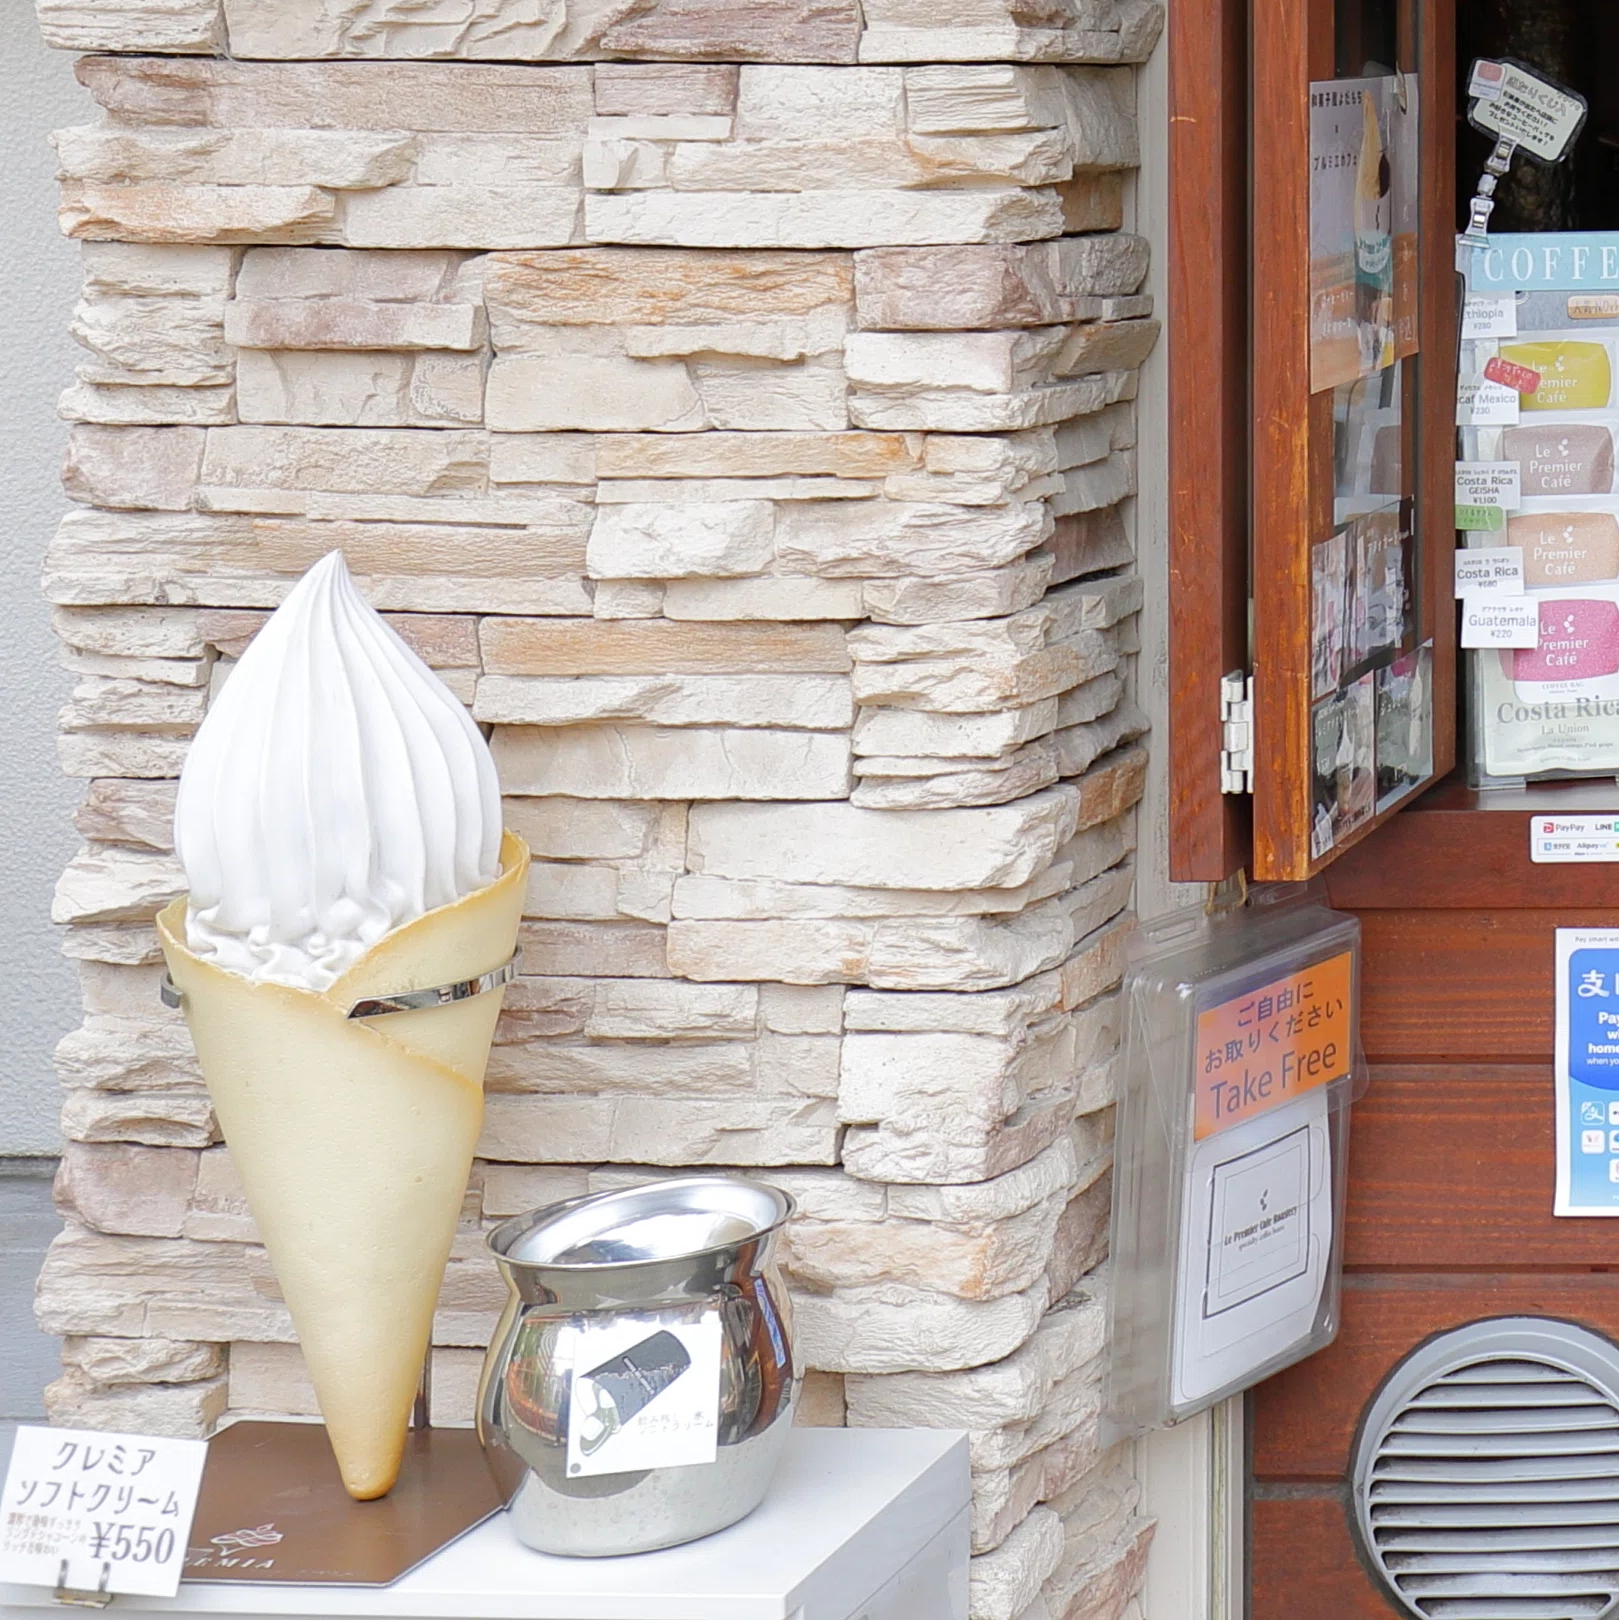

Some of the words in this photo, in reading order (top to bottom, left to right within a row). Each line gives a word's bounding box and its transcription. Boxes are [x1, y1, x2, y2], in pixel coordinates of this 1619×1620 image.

[1457, 477, 1487, 485] Costa
[1491, 476, 1513, 485] Rica
[1457, 570, 1490, 579] Costa
[1495, 567, 1518, 576] Rica
[1469, 615, 1536, 626] Guatemala
[1497, 698, 1567, 723] Costa
[1541, 725, 1553, 734] La
[1557, 723, 1589, 733] Union
[1237, 979, 1315, 1029] ご自由に
[1204, 996, 1344, 1073] お取りください
[1209, 1064, 1274, 1121] Take
[1280, 1038, 1338, 1092] Free
[52, 1442, 157, 1476] クレミア
[17, 1480, 179, 1517] ソフトクリーム
[90, 1521, 175, 1564] ¥550
